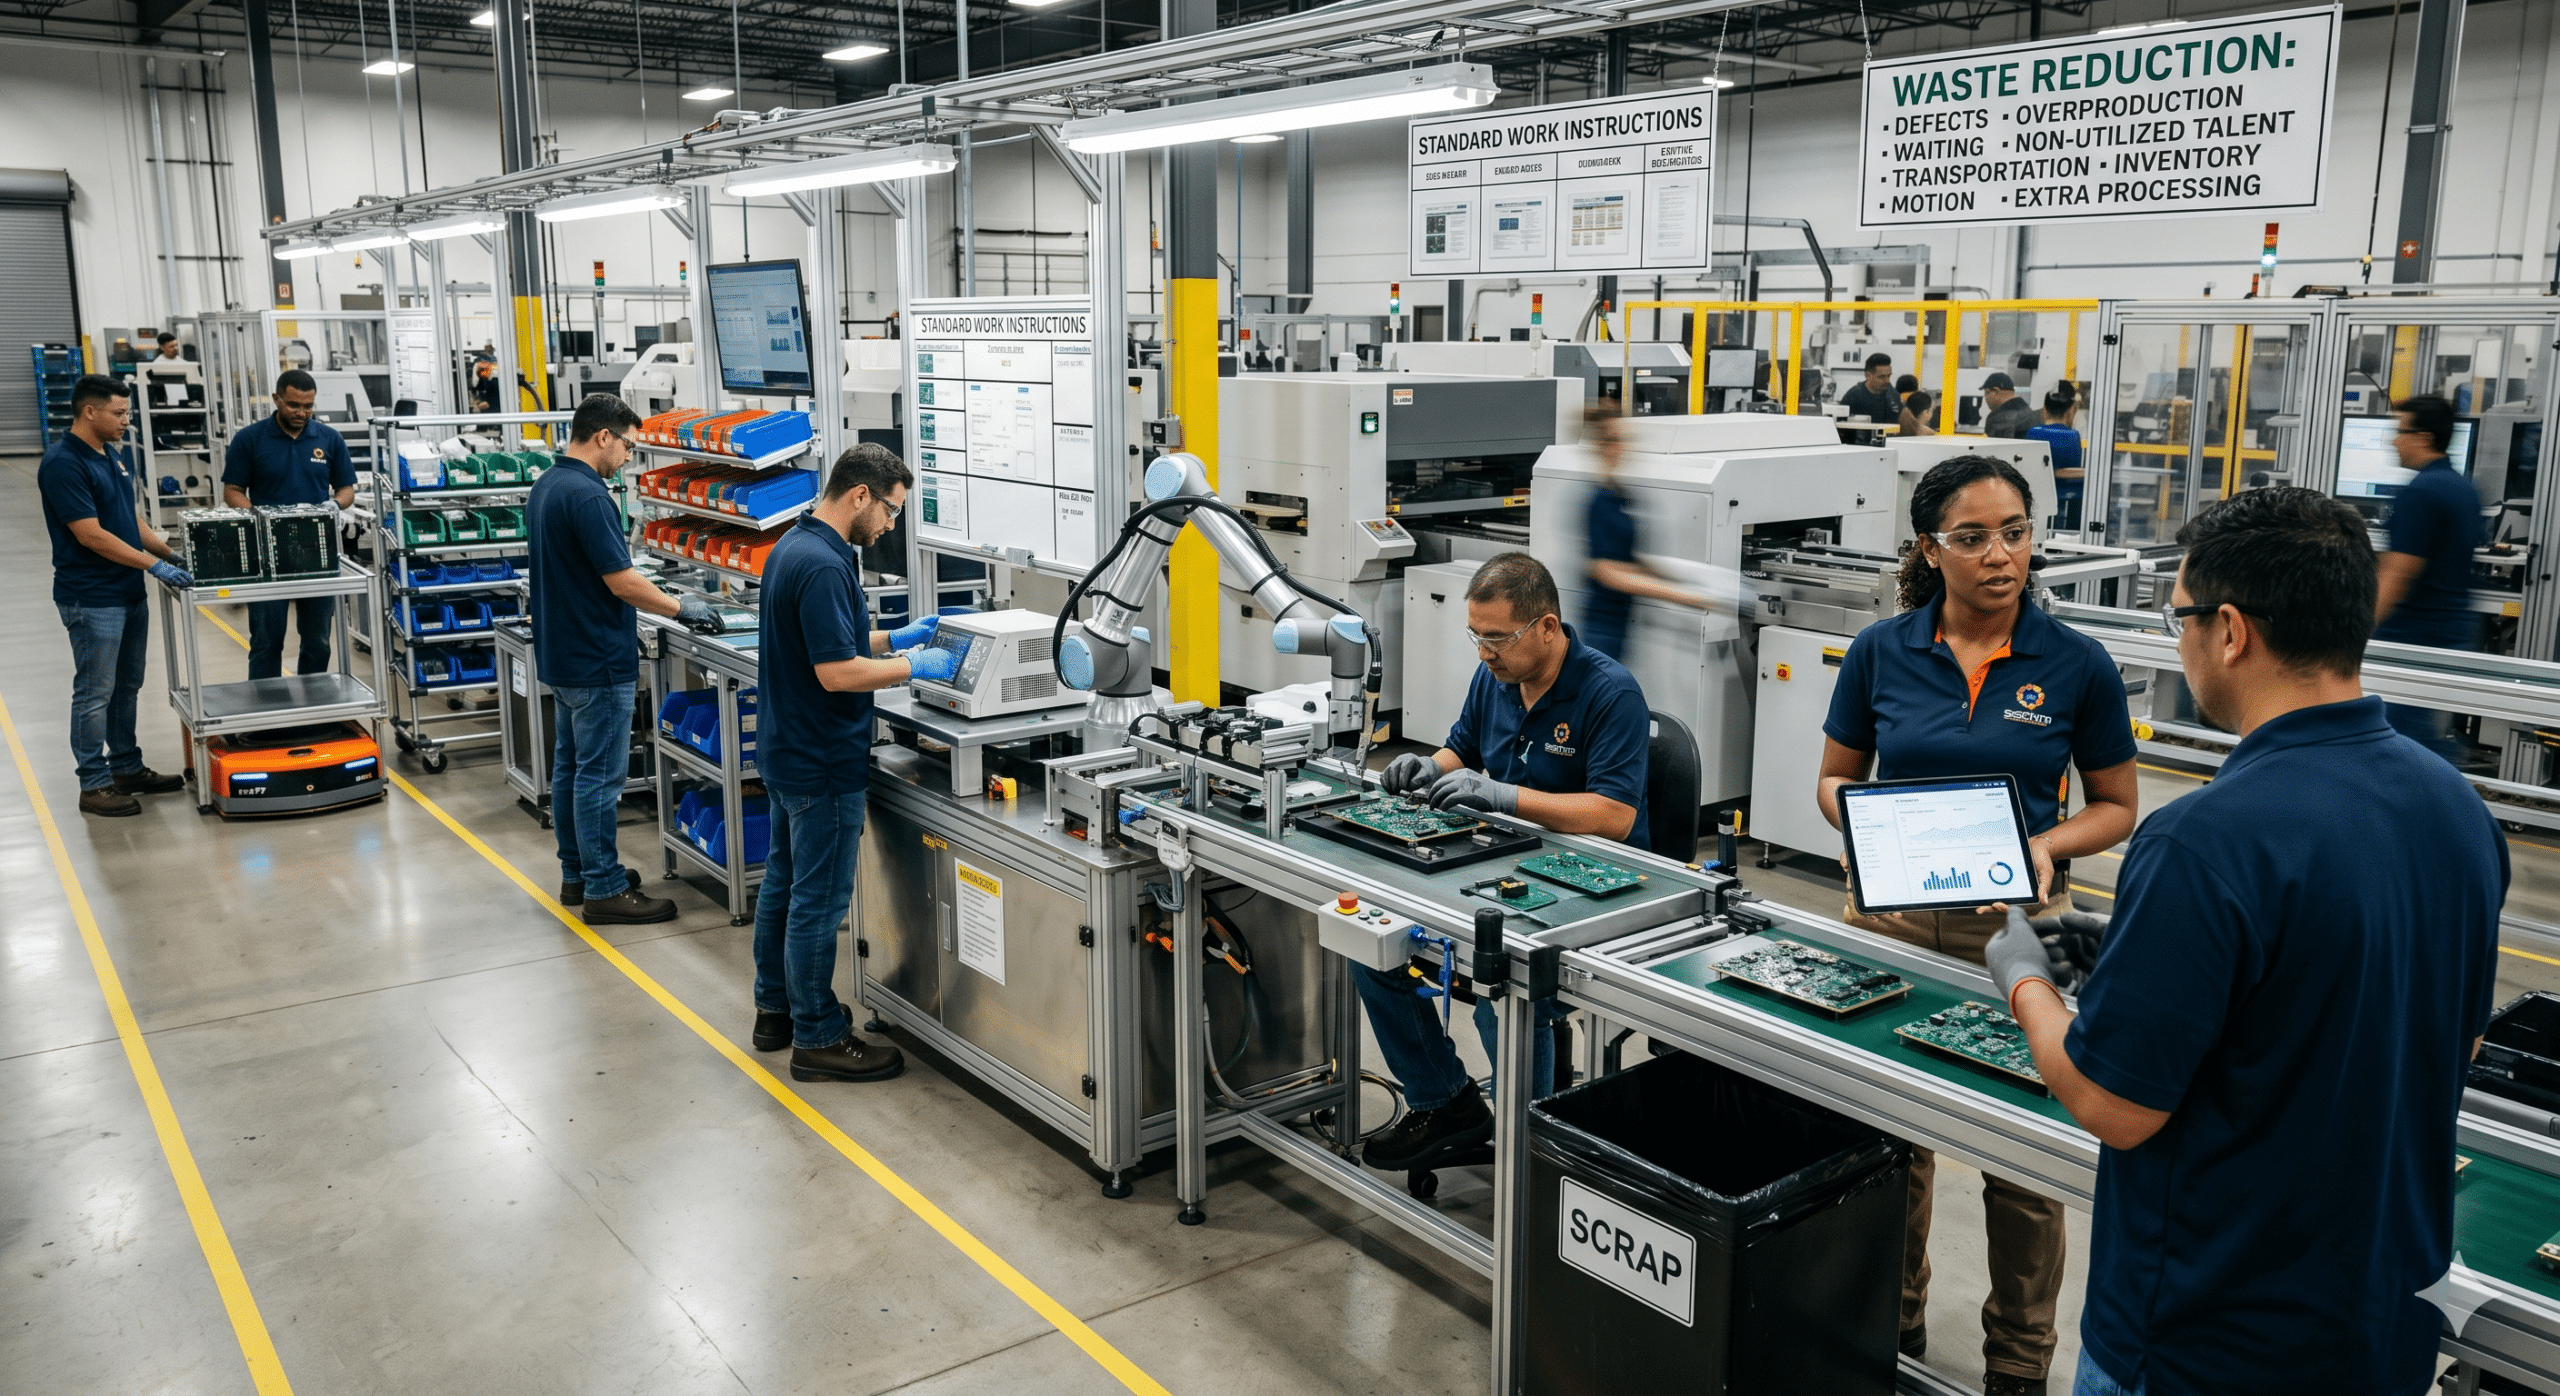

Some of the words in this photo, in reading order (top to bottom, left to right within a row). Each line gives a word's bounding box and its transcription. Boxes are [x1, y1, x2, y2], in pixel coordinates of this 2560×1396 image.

[1892, 62, 2019, 107] WASTE
[2032, 31, 2297, 94] REDUCTION:
[2015, 84, 2244, 126] OVERPRODUCTION
[1418, 129, 1503, 155] STANDARD
[1508, 122, 1559, 146] WORK
[1564, 106, 1703, 141] INSTRUCTIONS
[1895, 108, 1989, 136] DEFECTS
[2015, 119, 2186, 153] NON-UTILIZED
[2192, 110, 2296, 139] TALENT
[1894, 137, 1985, 162] WAITING
[2114, 143, 2262, 175] INVENTORY
[1892, 156, 2090, 188] TRANSPORTATION
[1891, 191, 1975, 214] MOTION
[2014, 185, 2090, 209] EXTRA
[2097, 174, 2262, 204] PROCESSING
[921, 317, 972, 334] STANDARD
[973, 317, 1004, 334] WORK
[1006, 316, 1087, 334] INSTRUCTIONS
[1570, 1208, 1682, 1286] SCRAP
